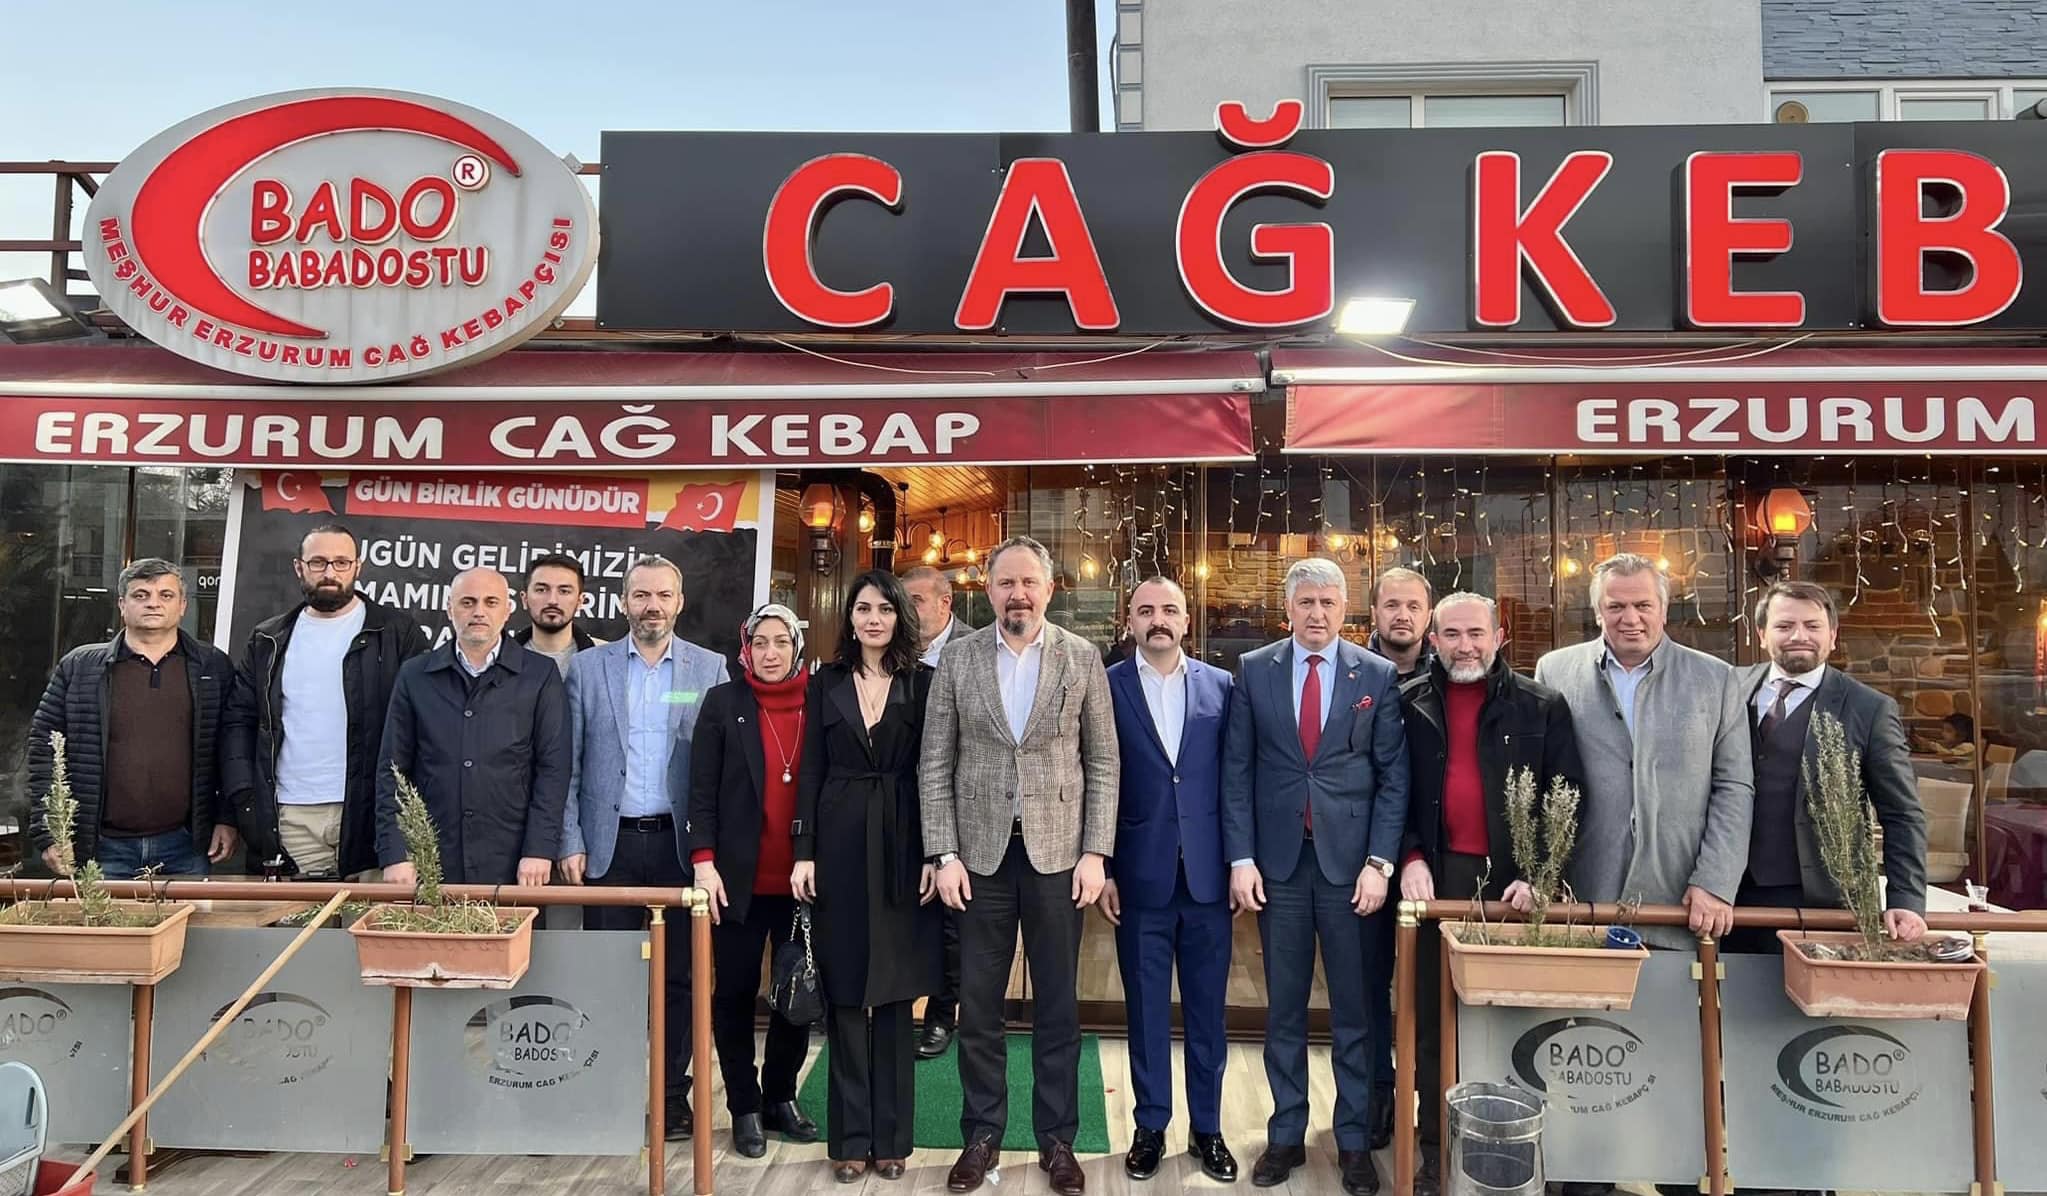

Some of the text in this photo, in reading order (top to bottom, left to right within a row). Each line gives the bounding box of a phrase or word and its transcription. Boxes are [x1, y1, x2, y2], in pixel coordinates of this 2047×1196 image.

[250, 175, 459, 246] BADO
[762, 100, 1335, 331] CAĞ
[248, 244, 489, 291] BABADOSTU
[98, 215, 574, 369] MEŞHUR ERZURUM CAĞ KEBAPÇISI
[35, 403, 981, 460] ERZURUM CAĞ KEBAP
[1576, 396, 2036, 443] ERZURUM
[354, 475, 640, 515] GÜN BİRLİK GÜNÜDÜR
[500, 1020, 572, 1045] BADO
[1549, 1042, 1626, 1068] BADO
[1815, 1051, 1893, 1076] BADO
[1815, 1078, 1899, 1094] BABADOSTU
[1807, 1108, 1857, 1122] ERZURUM
